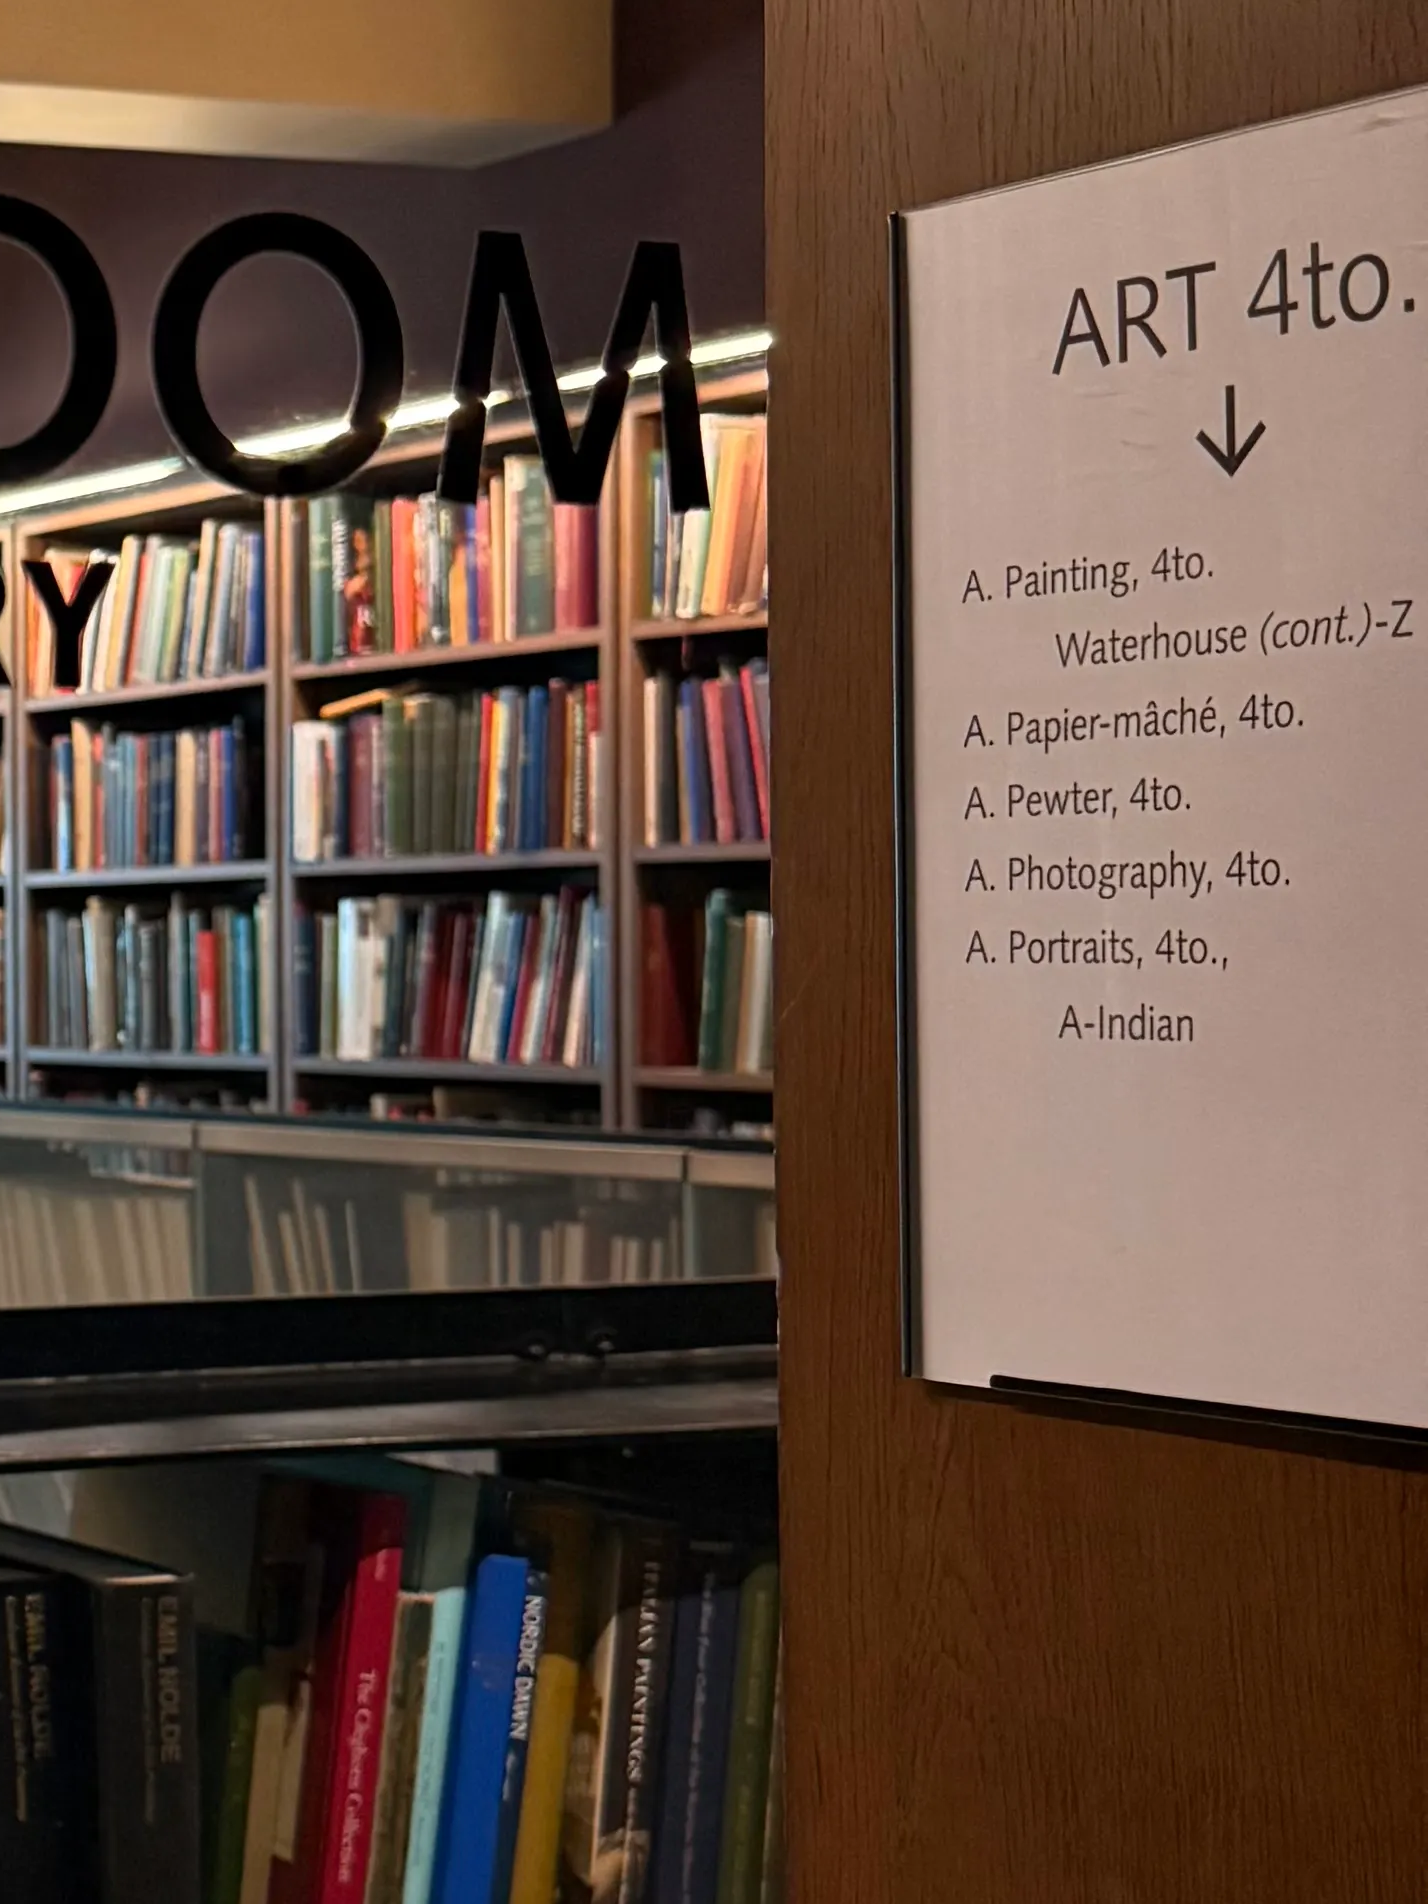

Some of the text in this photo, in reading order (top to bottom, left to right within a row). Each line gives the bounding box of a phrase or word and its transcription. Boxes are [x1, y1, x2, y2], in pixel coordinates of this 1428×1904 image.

[1051, 241, 1416, 376] ART 4to.
[961, 546, 1214, 604] A. Painting, 4to.
[1055, 600, 1415, 668] Waterhouse (cont.)-Z
[963, 694, 1305, 755] A. Papier-mâché, 4to.
[964, 777, 1192, 820] A. Pewter, 4to.
[964, 849, 1291, 900] A. Photography, 4to.
[965, 929, 1229, 971] A. Portraits, 4to.,
[1058, 1003, 1195, 1042] A-Indian
[516, 1595, 543, 1672] NORDIC
[158, 1667, 181, 1763] NOLDE
[356, 1668, 378, 1706] The
[509, 1676, 536, 1740] DAWN
[626, 1656, 652, 1785] PAINTINGS
